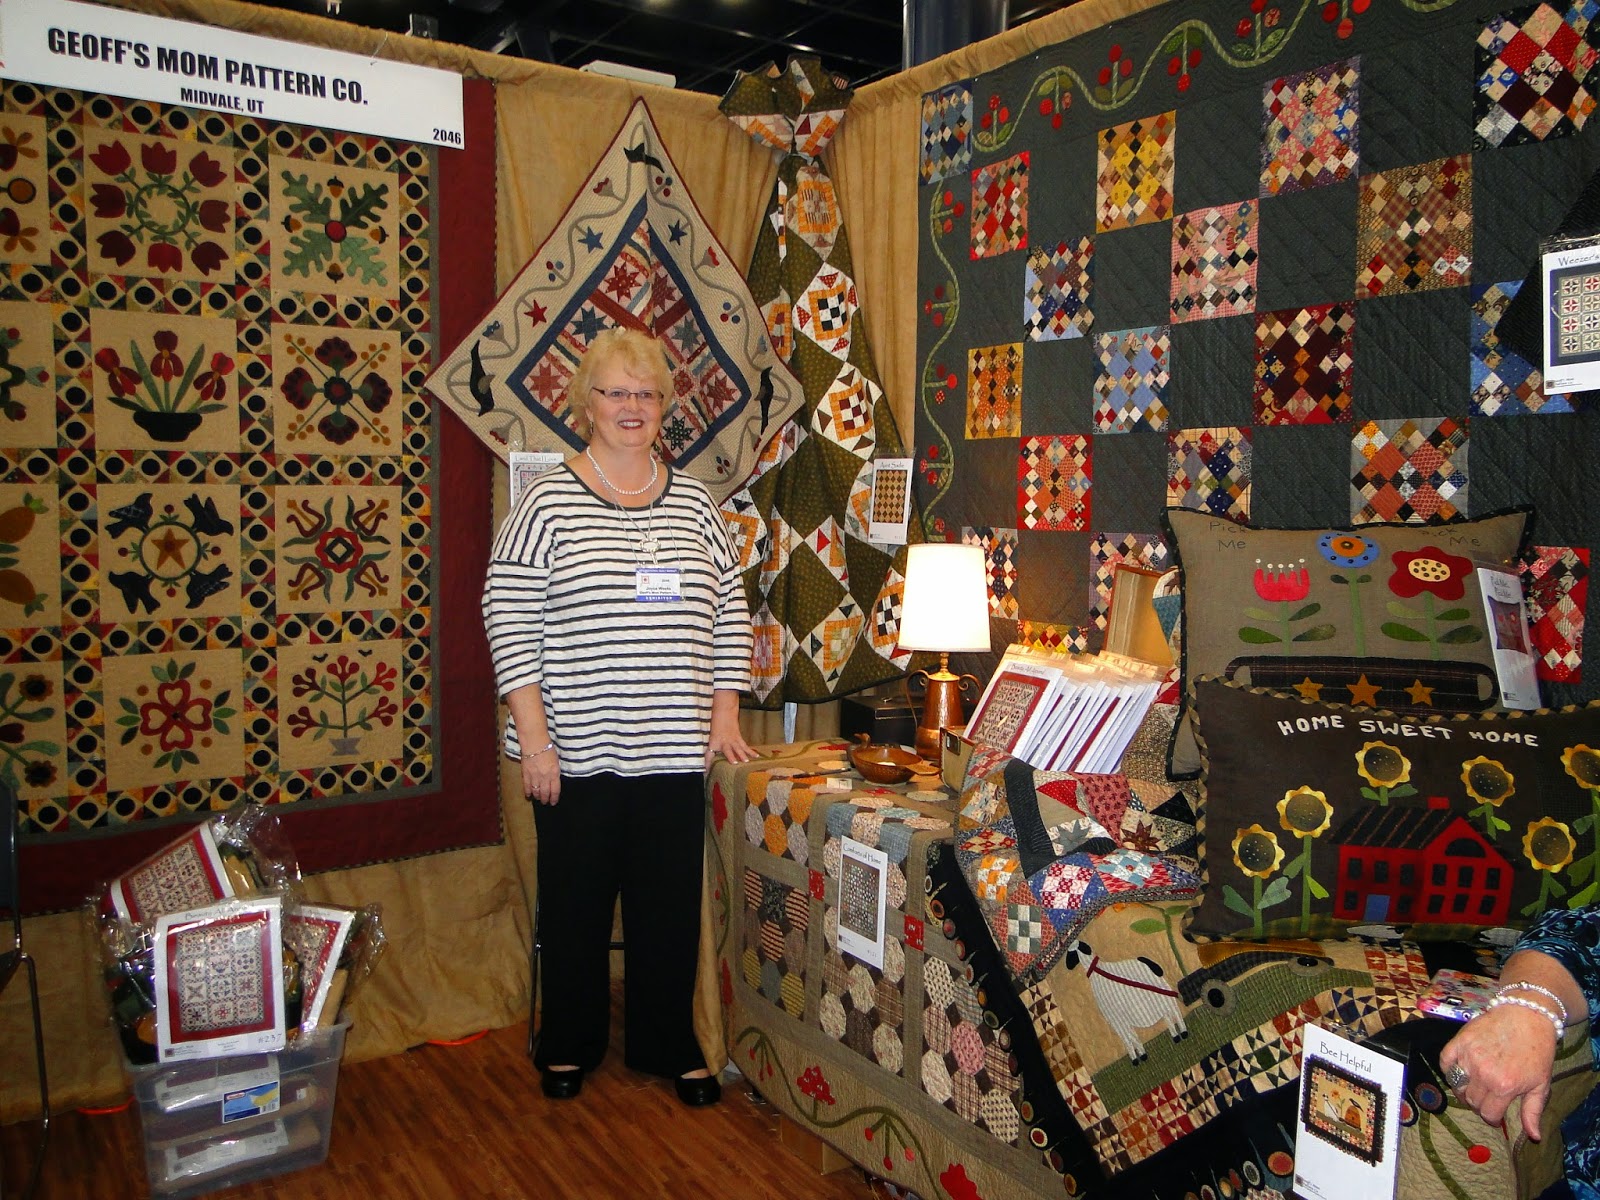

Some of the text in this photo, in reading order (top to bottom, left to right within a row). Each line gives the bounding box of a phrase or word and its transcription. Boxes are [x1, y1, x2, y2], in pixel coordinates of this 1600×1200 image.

[48, 28, 369, 105] GEOFF'S MOM PATTERN CO.
[180, 87, 265, 114] MIDVALE, UT
[432, 128, 462, 145] 2046
[1557, 254, 1600, 266] Weezer's
[1209, 521, 1247, 533] Pick
[1218, 540, 1246, 551] Me
[1450, 536, 1480, 546] Me
[1277, 715, 1539, 748] HOME SWEET HOME
[1319, 1041, 1372, 1073] Bee Helpful
